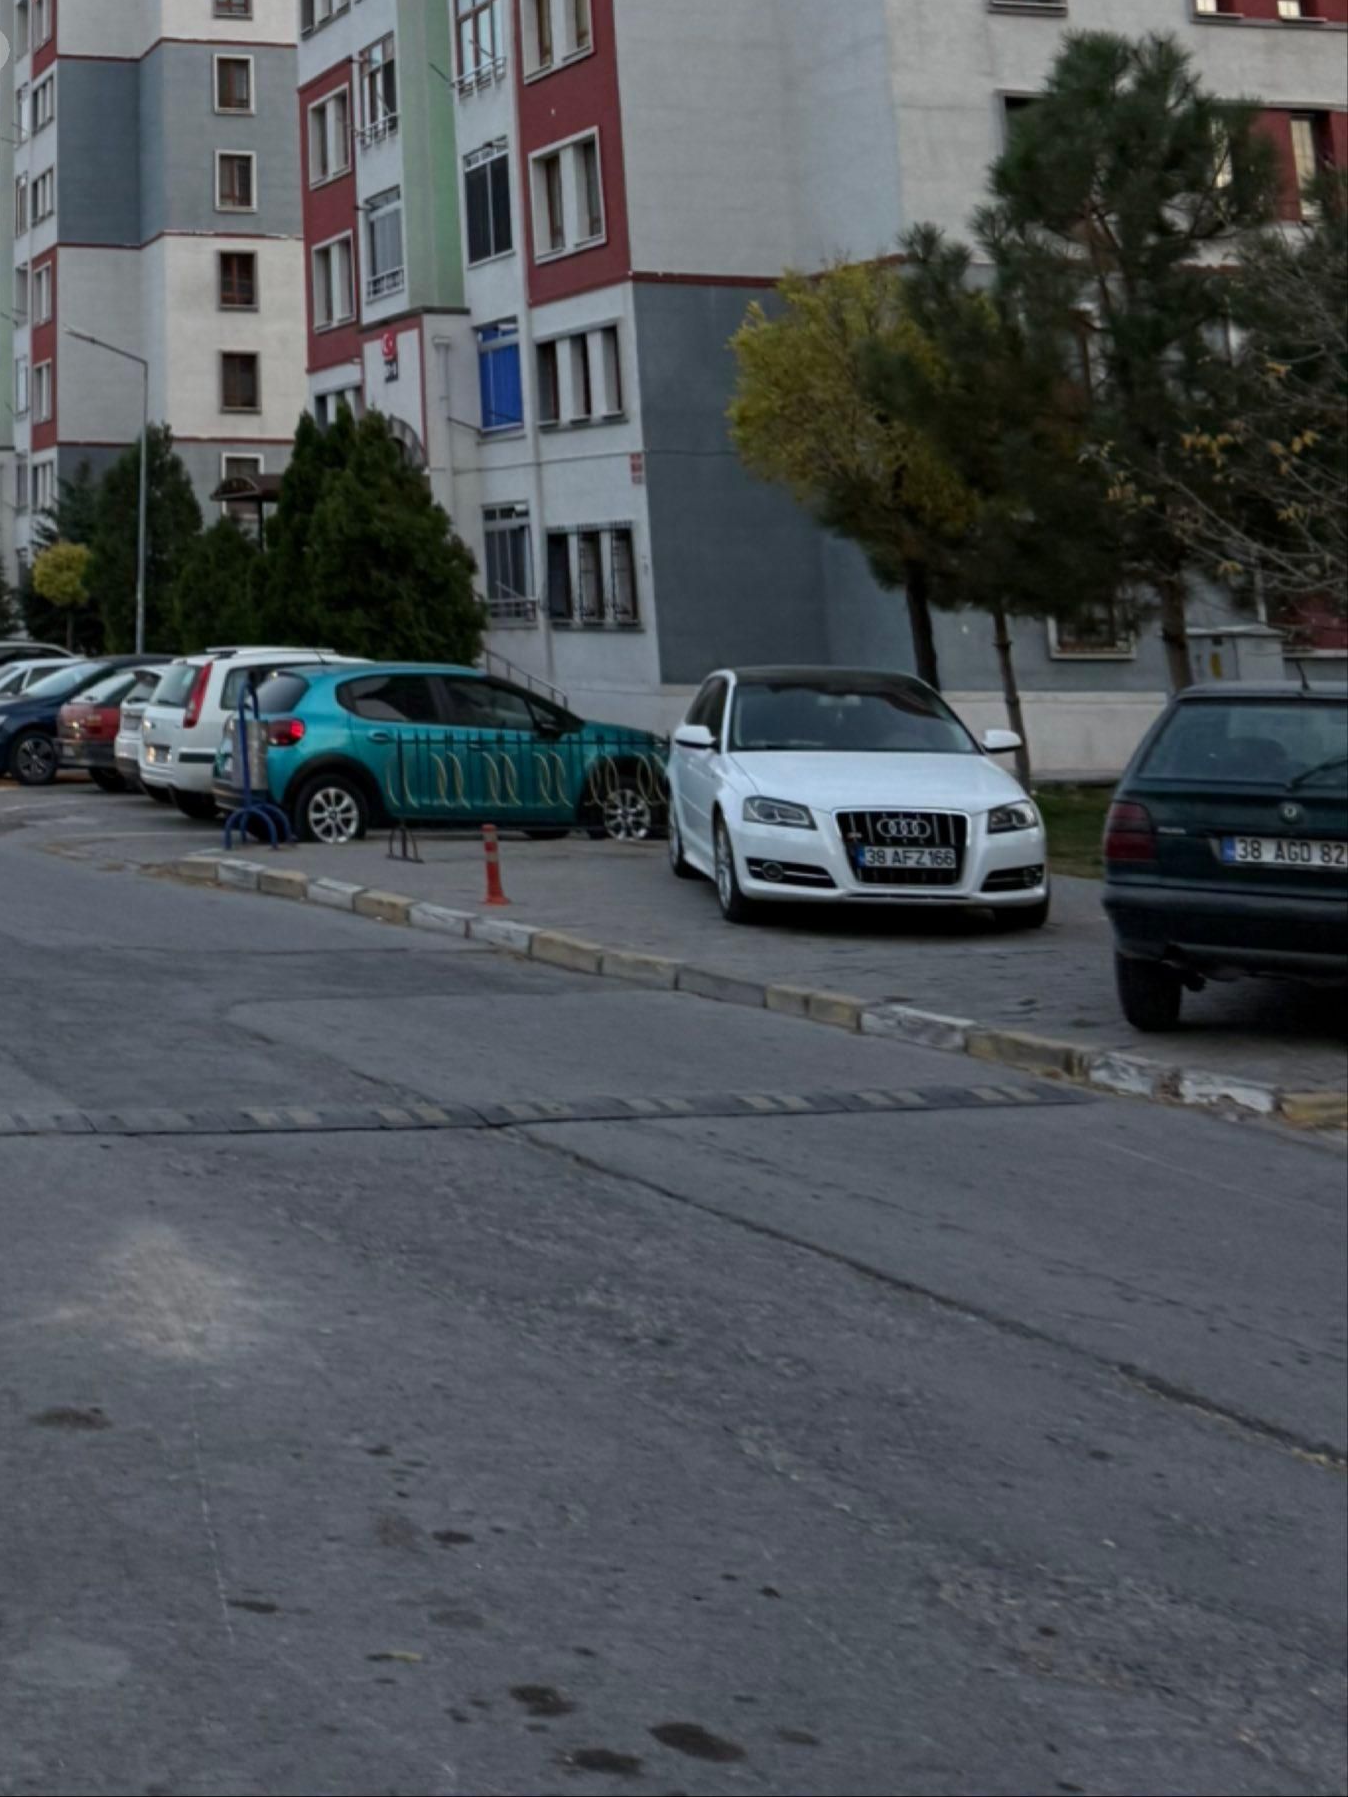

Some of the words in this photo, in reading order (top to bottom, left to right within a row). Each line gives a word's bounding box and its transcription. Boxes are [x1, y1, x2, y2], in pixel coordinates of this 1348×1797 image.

[866, 848, 886, 865] 38
[891, 849, 926, 866] AFZ
[927, 849, 955, 867] 166
[1238, 838, 1262, 859] 38
